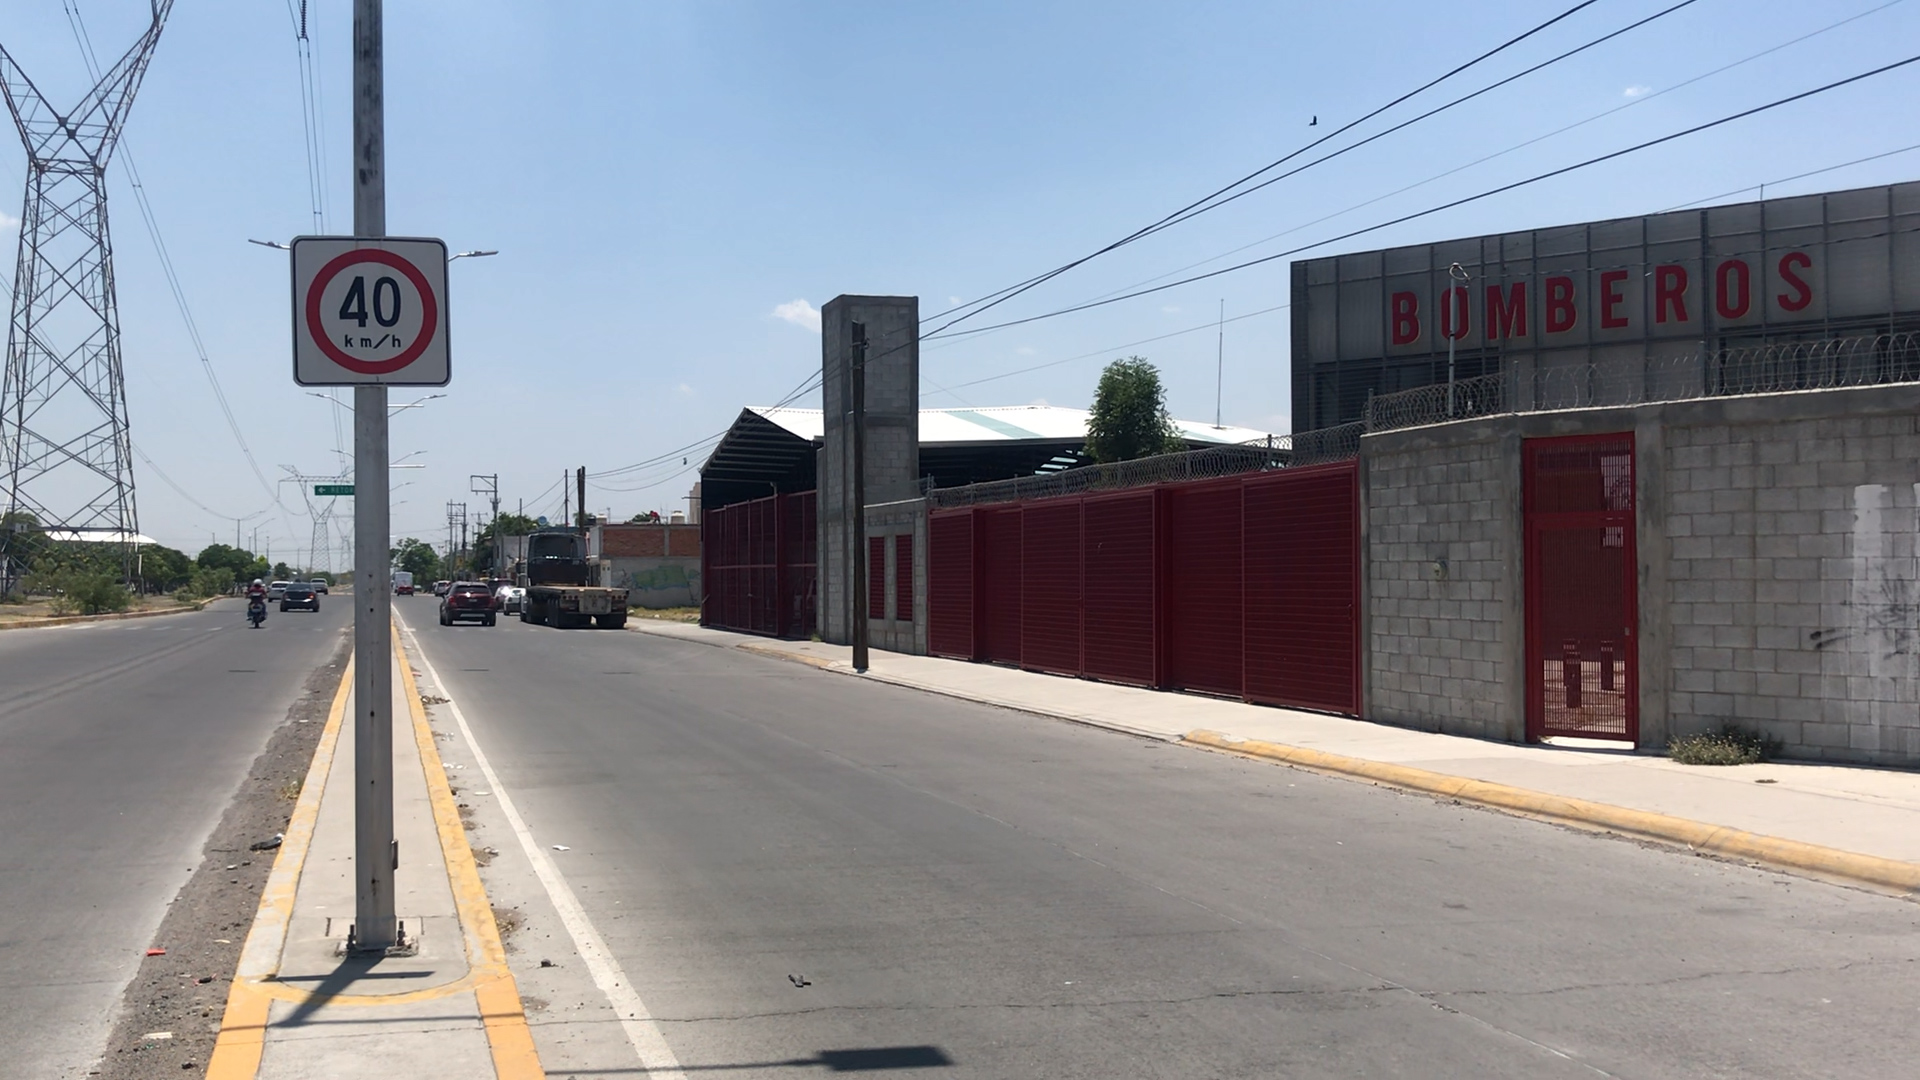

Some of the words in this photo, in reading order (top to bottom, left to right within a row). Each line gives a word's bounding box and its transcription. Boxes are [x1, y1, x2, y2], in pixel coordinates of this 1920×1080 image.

[339, 276, 401, 328] 40
[1391, 252, 1812, 345] BOMBEROS
[344, 334, 402, 349] km/h
